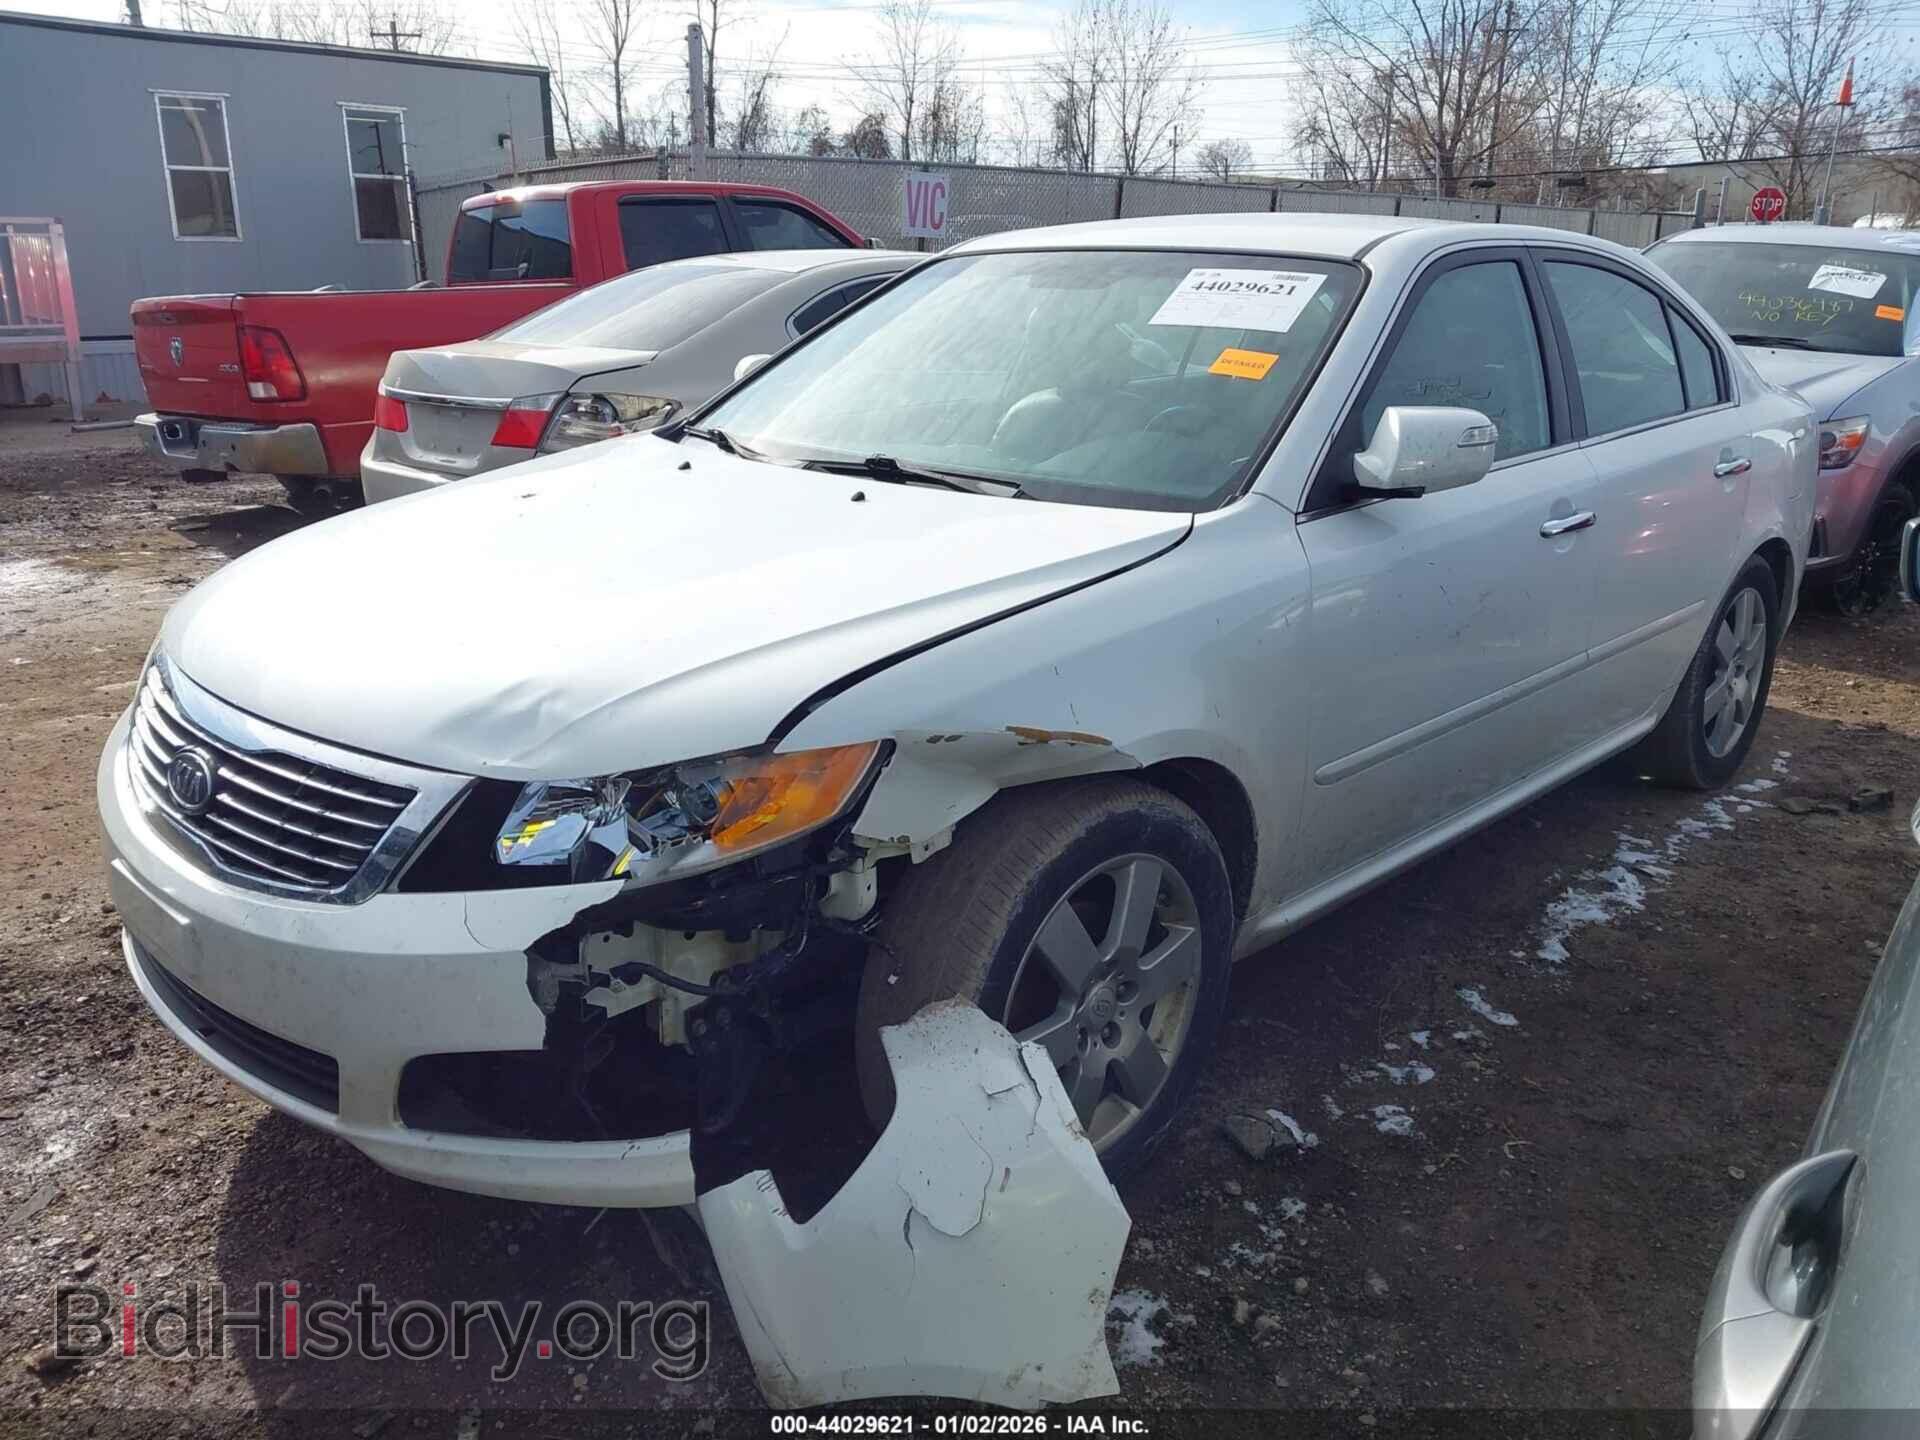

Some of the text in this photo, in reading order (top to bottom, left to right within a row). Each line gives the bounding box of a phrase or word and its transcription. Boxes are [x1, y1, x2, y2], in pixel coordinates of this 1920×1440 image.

[906, 179, 945, 230] VIC
[1753, 197, 1782, 211] STOP
[1191, 280, 1297, 296] 44029621
[1751, 311, 1839, 326] NO KEY
